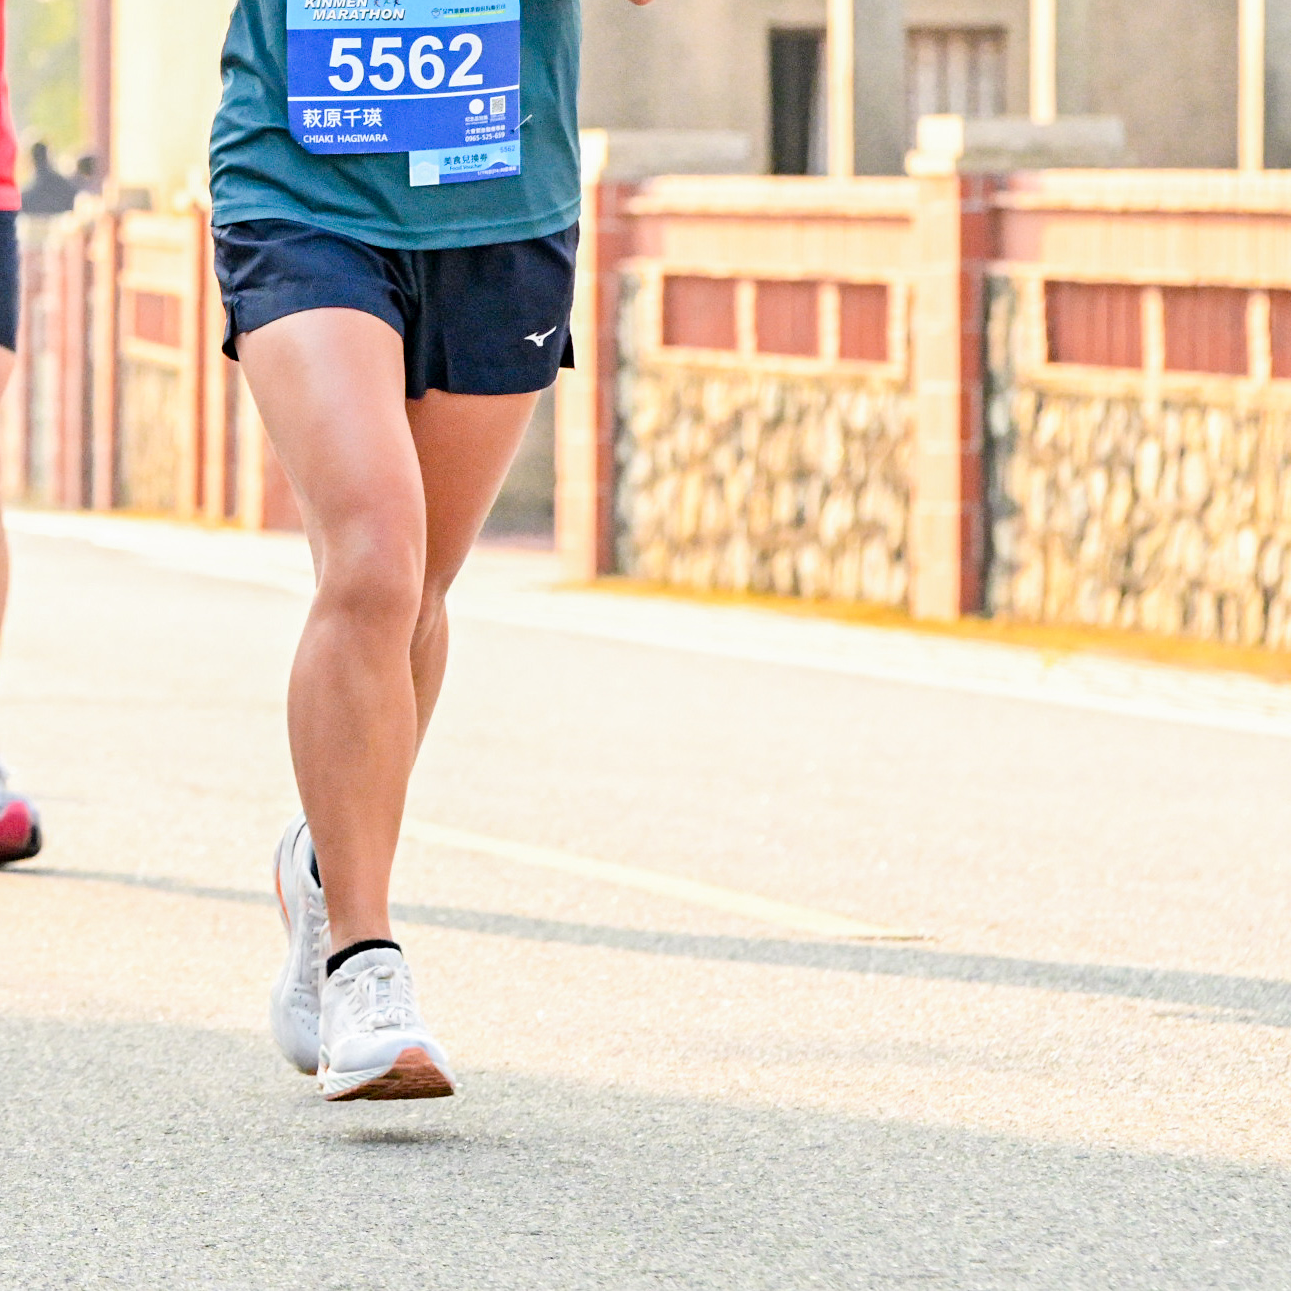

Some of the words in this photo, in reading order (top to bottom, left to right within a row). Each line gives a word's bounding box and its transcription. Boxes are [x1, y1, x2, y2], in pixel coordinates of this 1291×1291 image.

[312, 9, 406, 21] MARATHON
[328, 33, 484, 92] 5562
[303, 107, 383, 128] 萩原千瑛
[303, 134, 334, 143] CHIAKI
[337, 133, 388, 143] HAGIWARA
